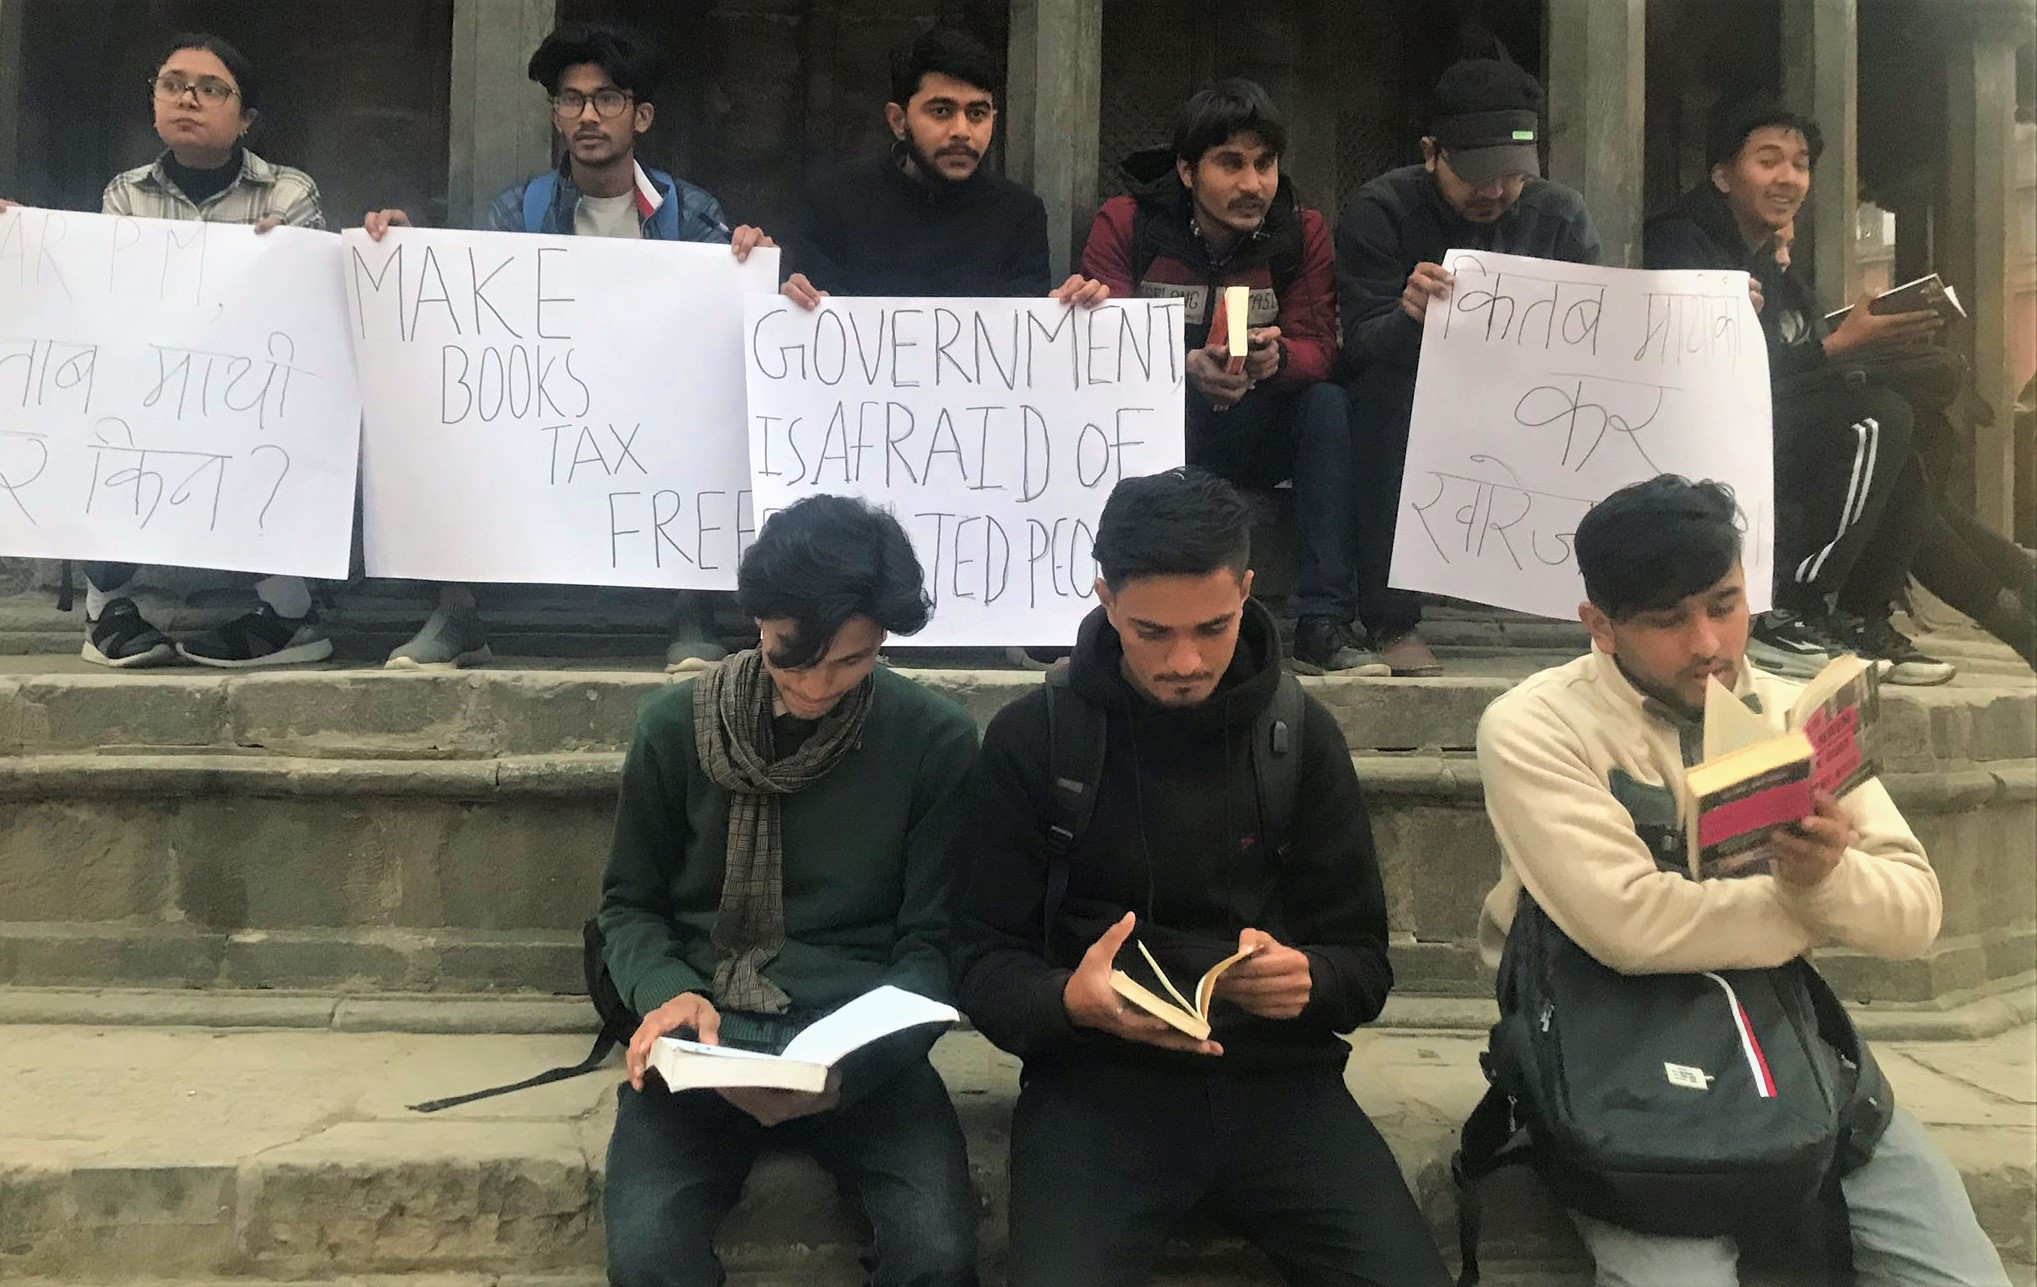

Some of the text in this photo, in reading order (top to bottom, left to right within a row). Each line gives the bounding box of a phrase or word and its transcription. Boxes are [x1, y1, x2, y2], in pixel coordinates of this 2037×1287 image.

[0, 211, 74, 303] AR
[352, 243, 576, 342] MAKE
[441, 344, 591, 425] BOOKS
[1513, 371, 1684, 474] कर
[541, 422, 648, 485] TAX
[1076, 407, 1155, 488] OF
[1026, 516, 1097, 609] PEO
